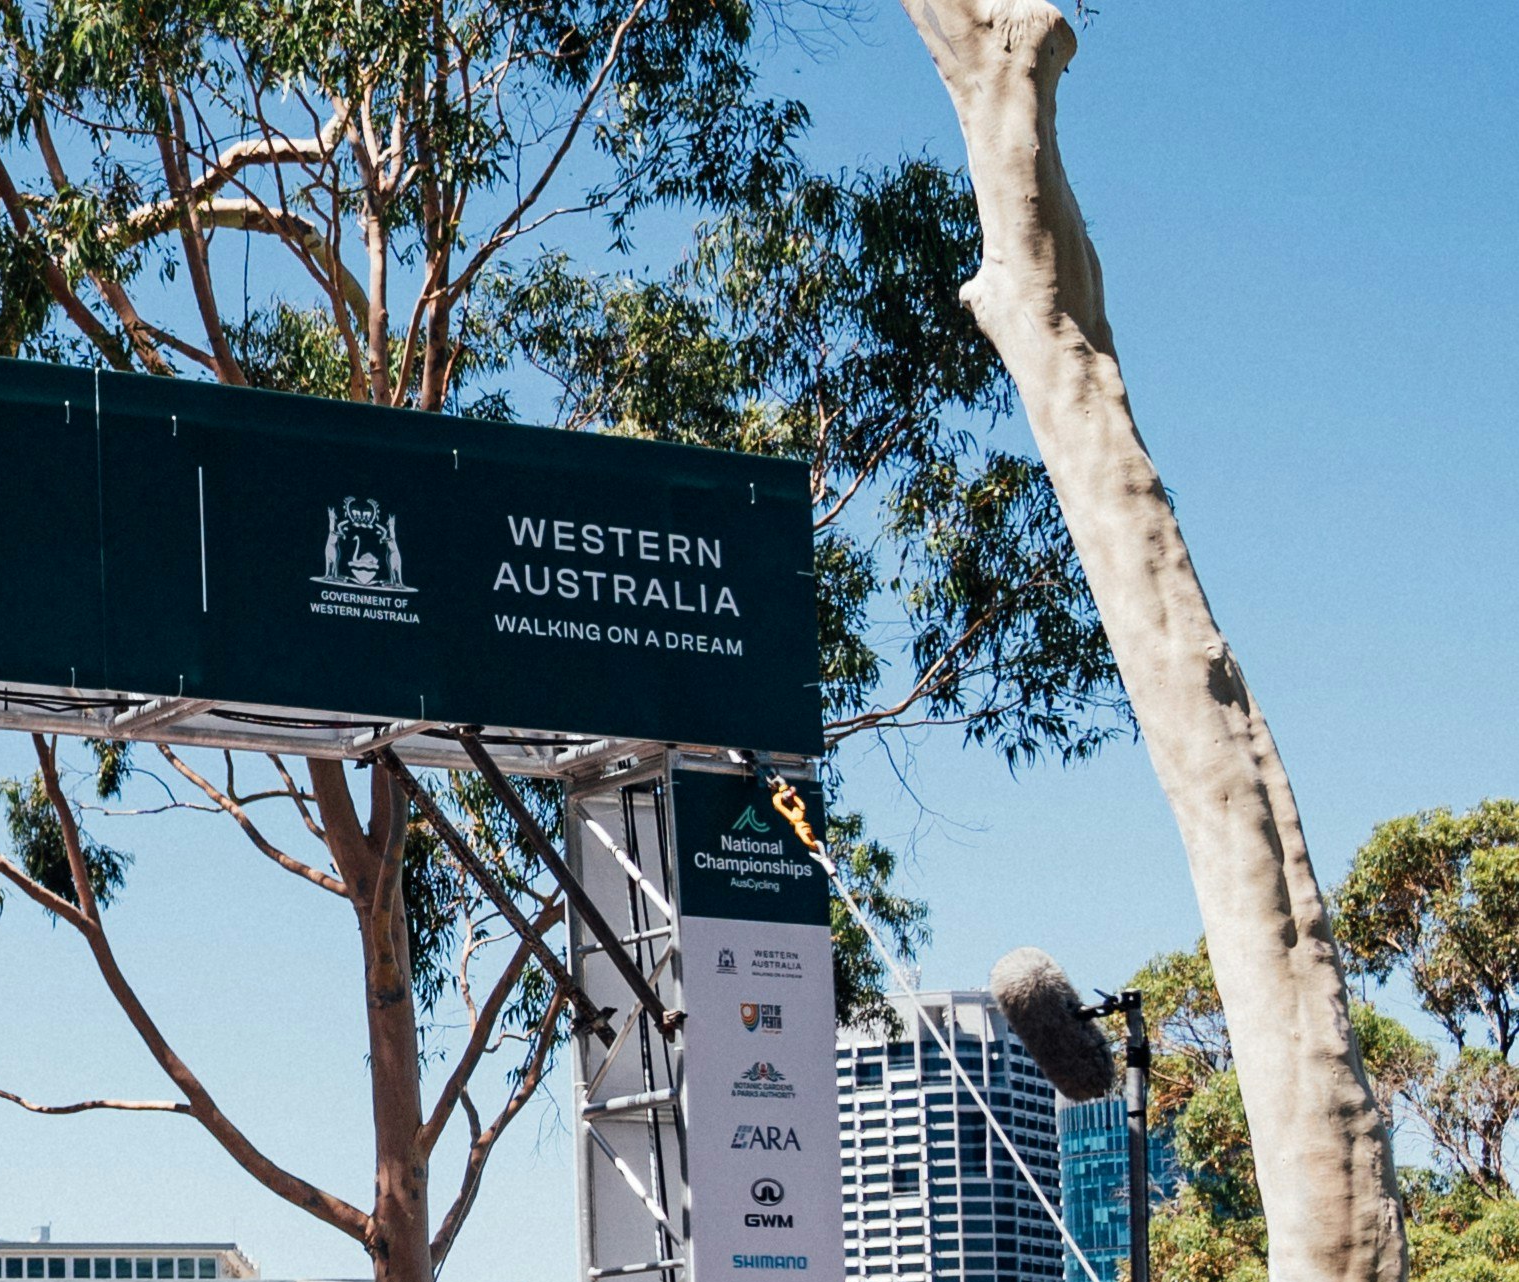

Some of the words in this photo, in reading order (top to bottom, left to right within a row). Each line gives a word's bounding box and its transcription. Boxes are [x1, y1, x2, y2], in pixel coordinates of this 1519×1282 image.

[508, 515, 722, 568] WESTERN
[320, 591, 392, 606] GOVERNMENT
[394, 597, 408, 608] OF
[493, 562, 740, 617] AUSTRALIA
[309, 603, 361, 617] WESTERN
[362, 609, 420, 624] AUSTRALIA
[494, 614, 602, 642] WALKING
[607, 627, 639, 645] ON
[645, 631, 661, 648] A
[665, 633, 743, 657] DREAM
[721, 835, 783, 855] National
[694, 853, 812, 877] Championships
[730, 877, 780, 892] AusCycling
[751, 960, 802, 970] AUSTRALIA
[754, 950, 798, 960] WESTERN
[748, 1126, 802, 1151] ARA
[745, 1214, 793, 1228] GWM
[733, 1254, 808, 1269] SHIMANO
